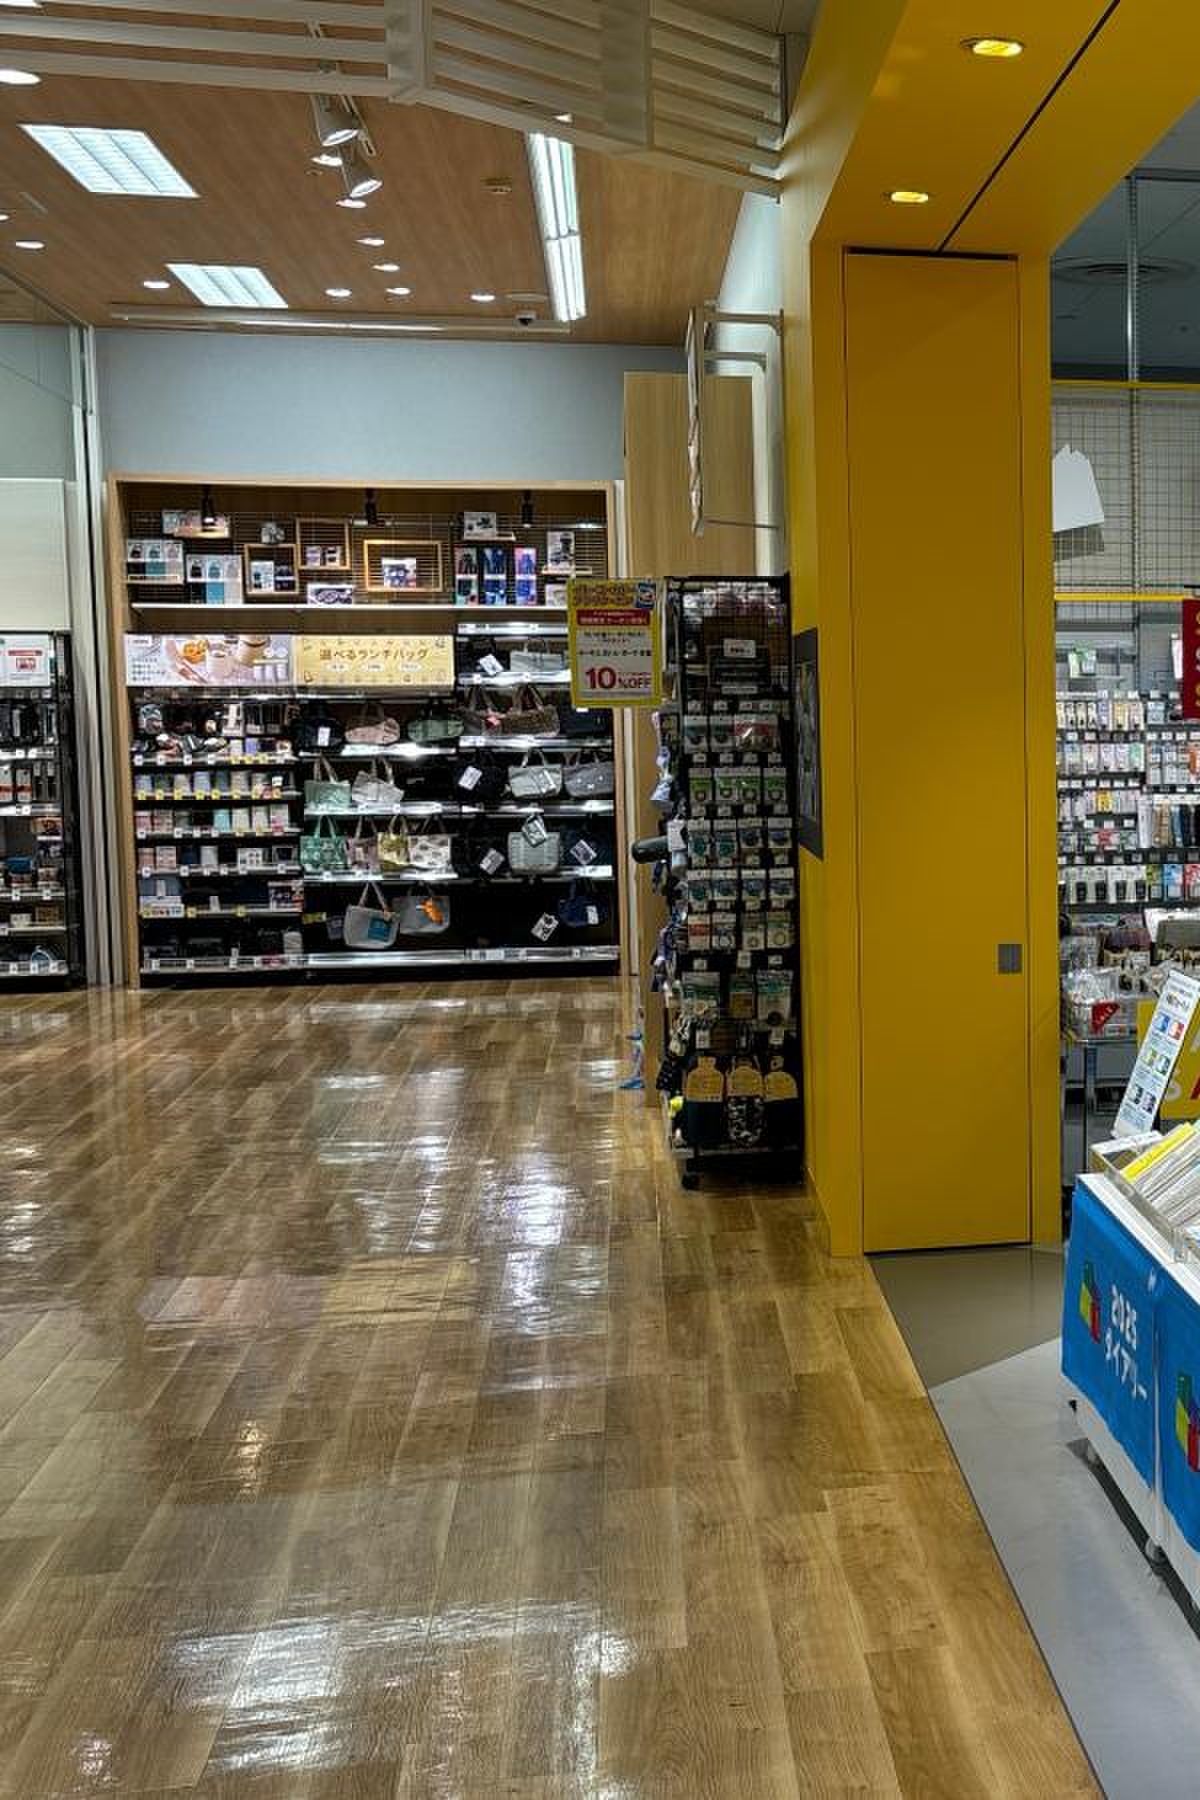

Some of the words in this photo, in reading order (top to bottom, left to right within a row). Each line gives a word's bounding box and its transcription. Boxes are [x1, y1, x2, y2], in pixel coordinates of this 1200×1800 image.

[1112, 1284, 1137, 1351] 2025
[1105, 1328, 1147, 1400] ダイアリー
